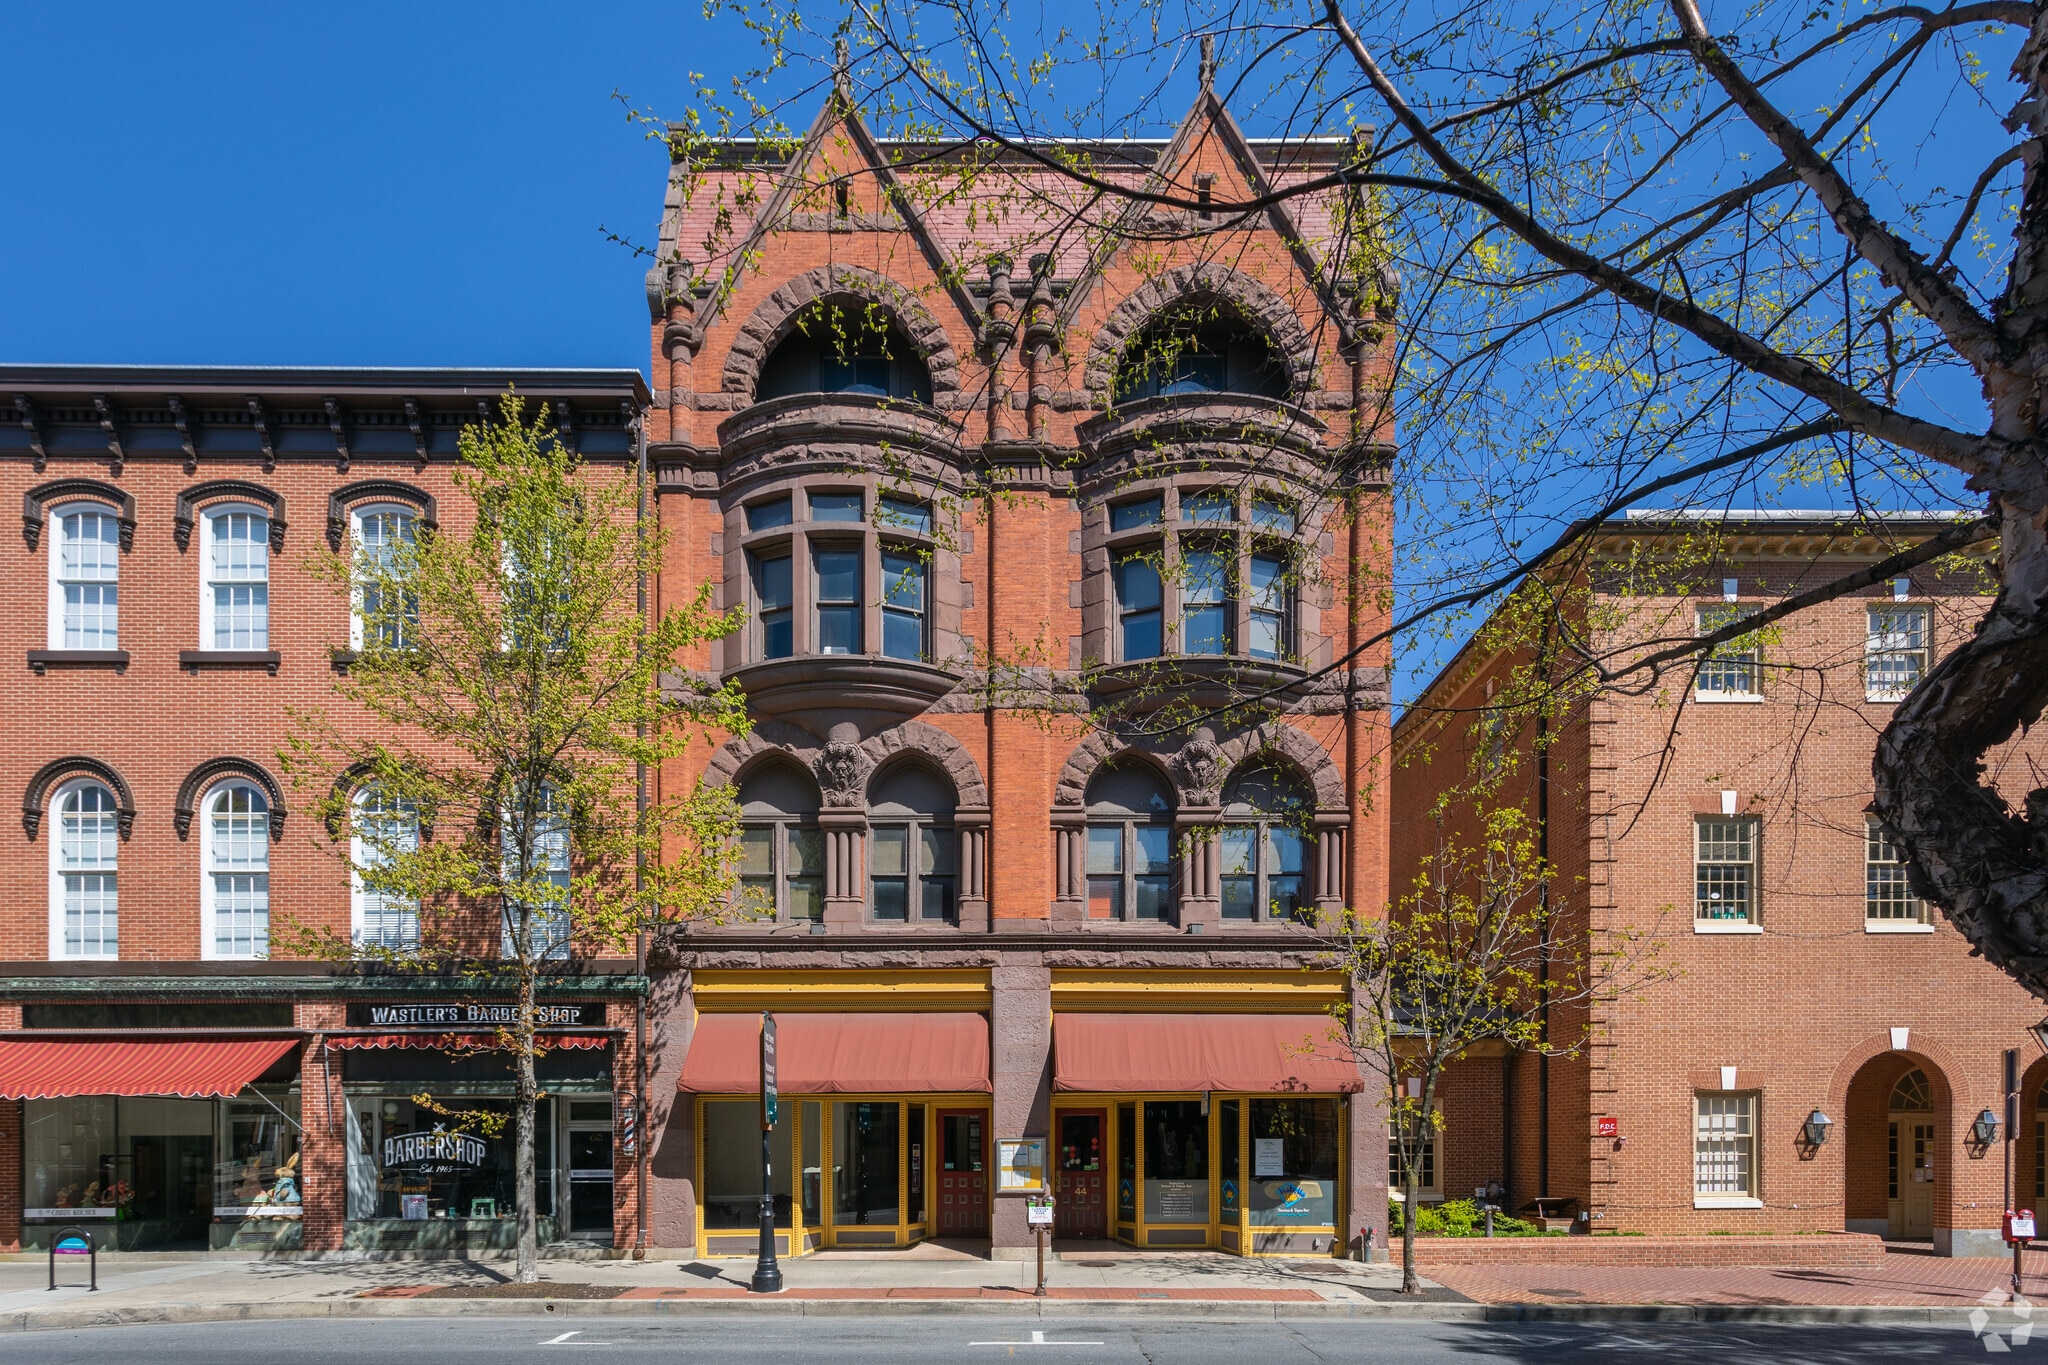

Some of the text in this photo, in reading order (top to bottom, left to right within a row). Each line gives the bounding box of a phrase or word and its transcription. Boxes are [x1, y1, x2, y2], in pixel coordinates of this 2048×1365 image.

[371, 1006, 580, 1023] WASTLER'S BARBE SHOP
[384, 1133, 487, 1167] BARBERSHOP
[435, 1165, 453, 1173] 1965
[1074, 1187, 1087, 1196] 44
